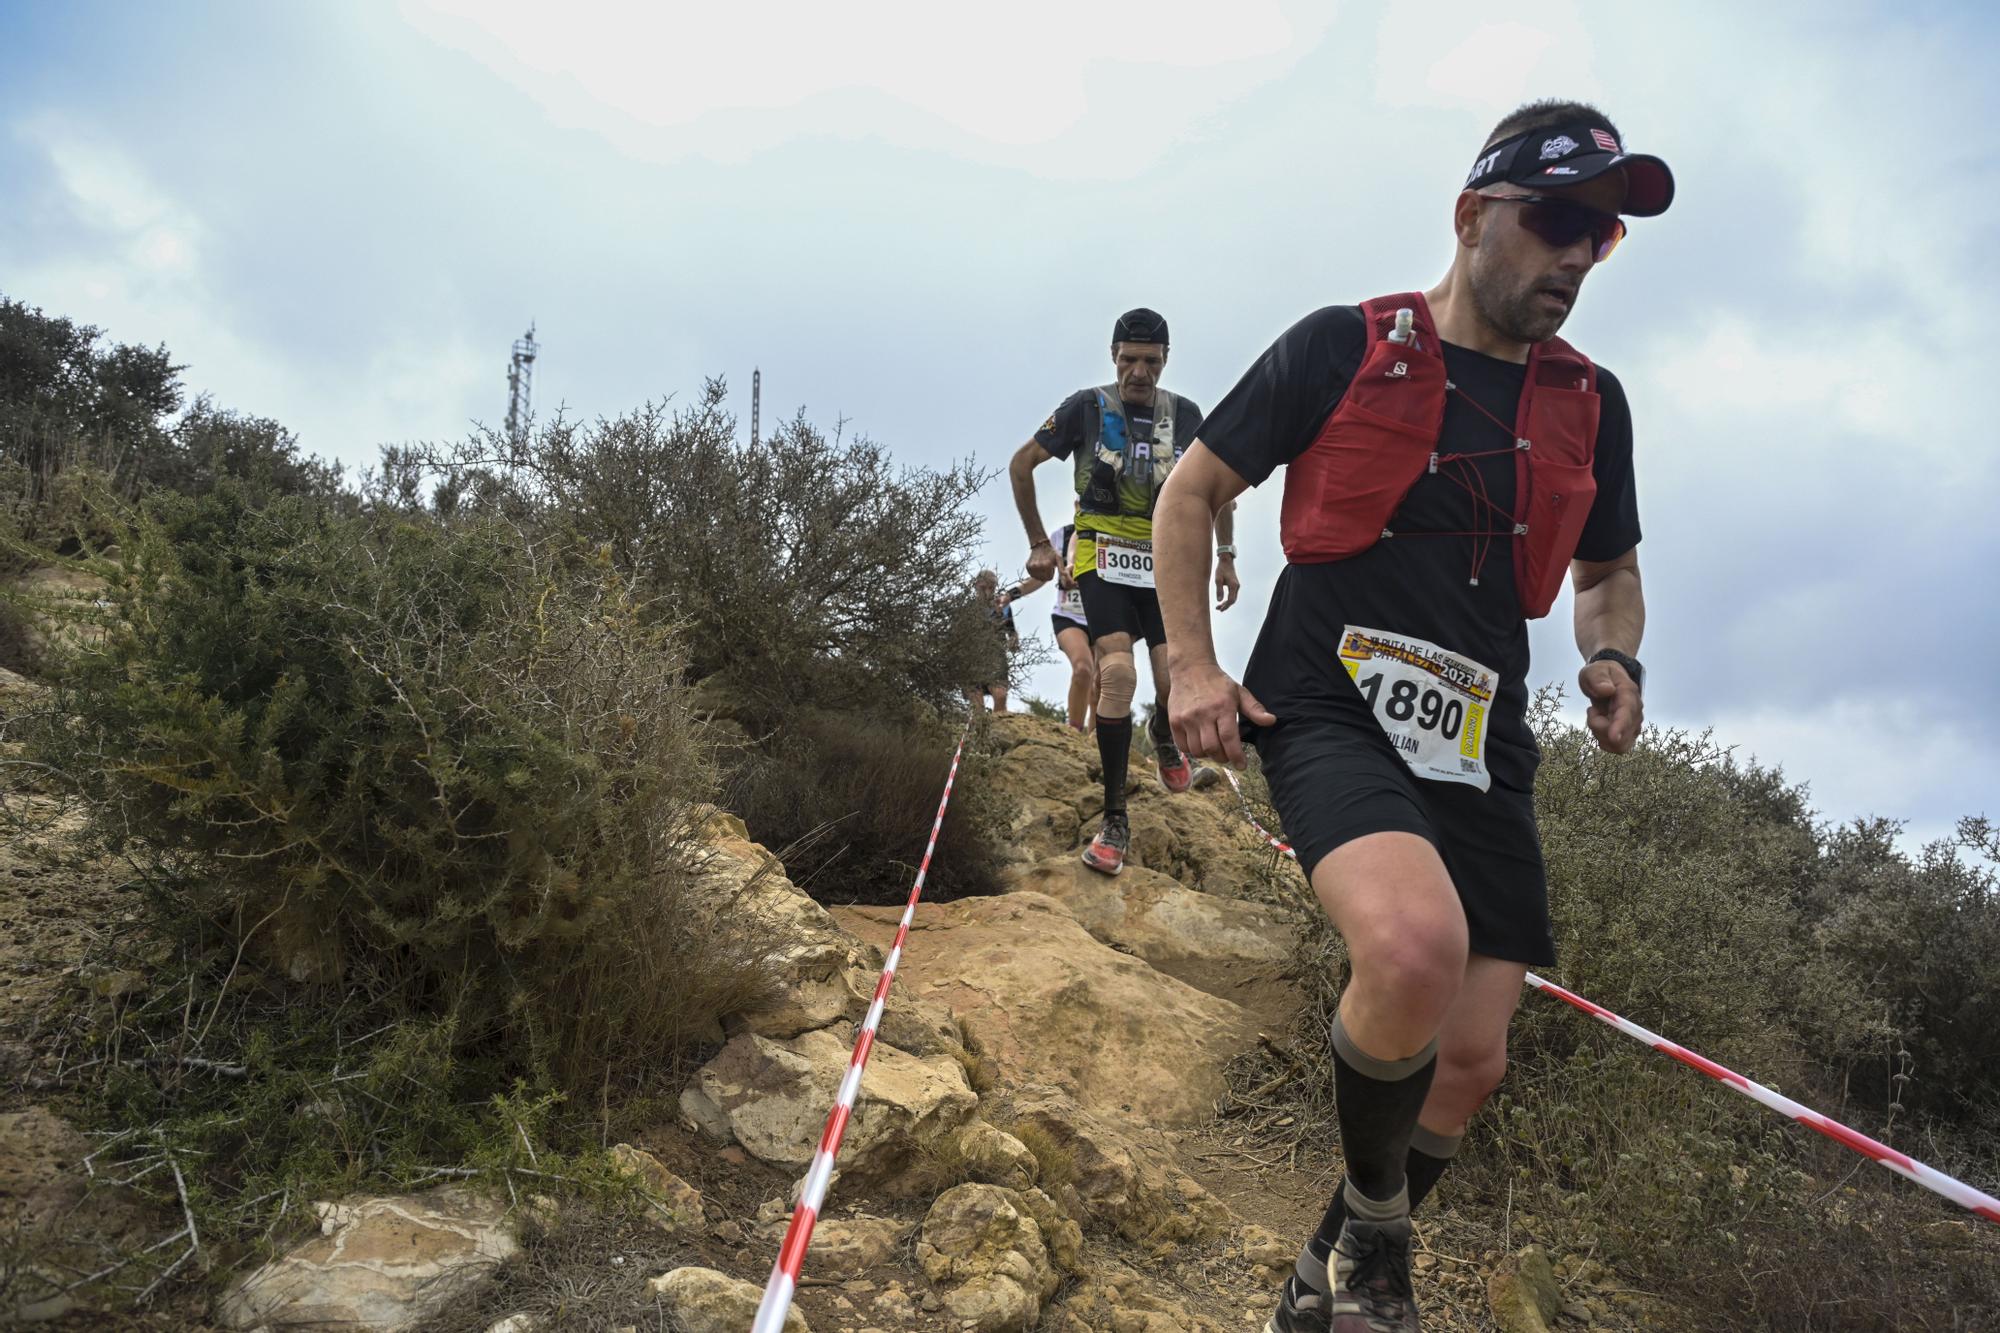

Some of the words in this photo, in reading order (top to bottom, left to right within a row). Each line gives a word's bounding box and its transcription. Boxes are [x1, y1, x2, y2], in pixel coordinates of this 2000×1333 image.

[1108, 552, 1153, 572] 3080
[1382, 637, 1406, 653] RUTA
[1409, 644, 1423, 656] DE
[1425, 649, 1443, 663] LAS
[1440, 664, 1475, 689] 2023
[1360, 673, 1463, 740] 1890
